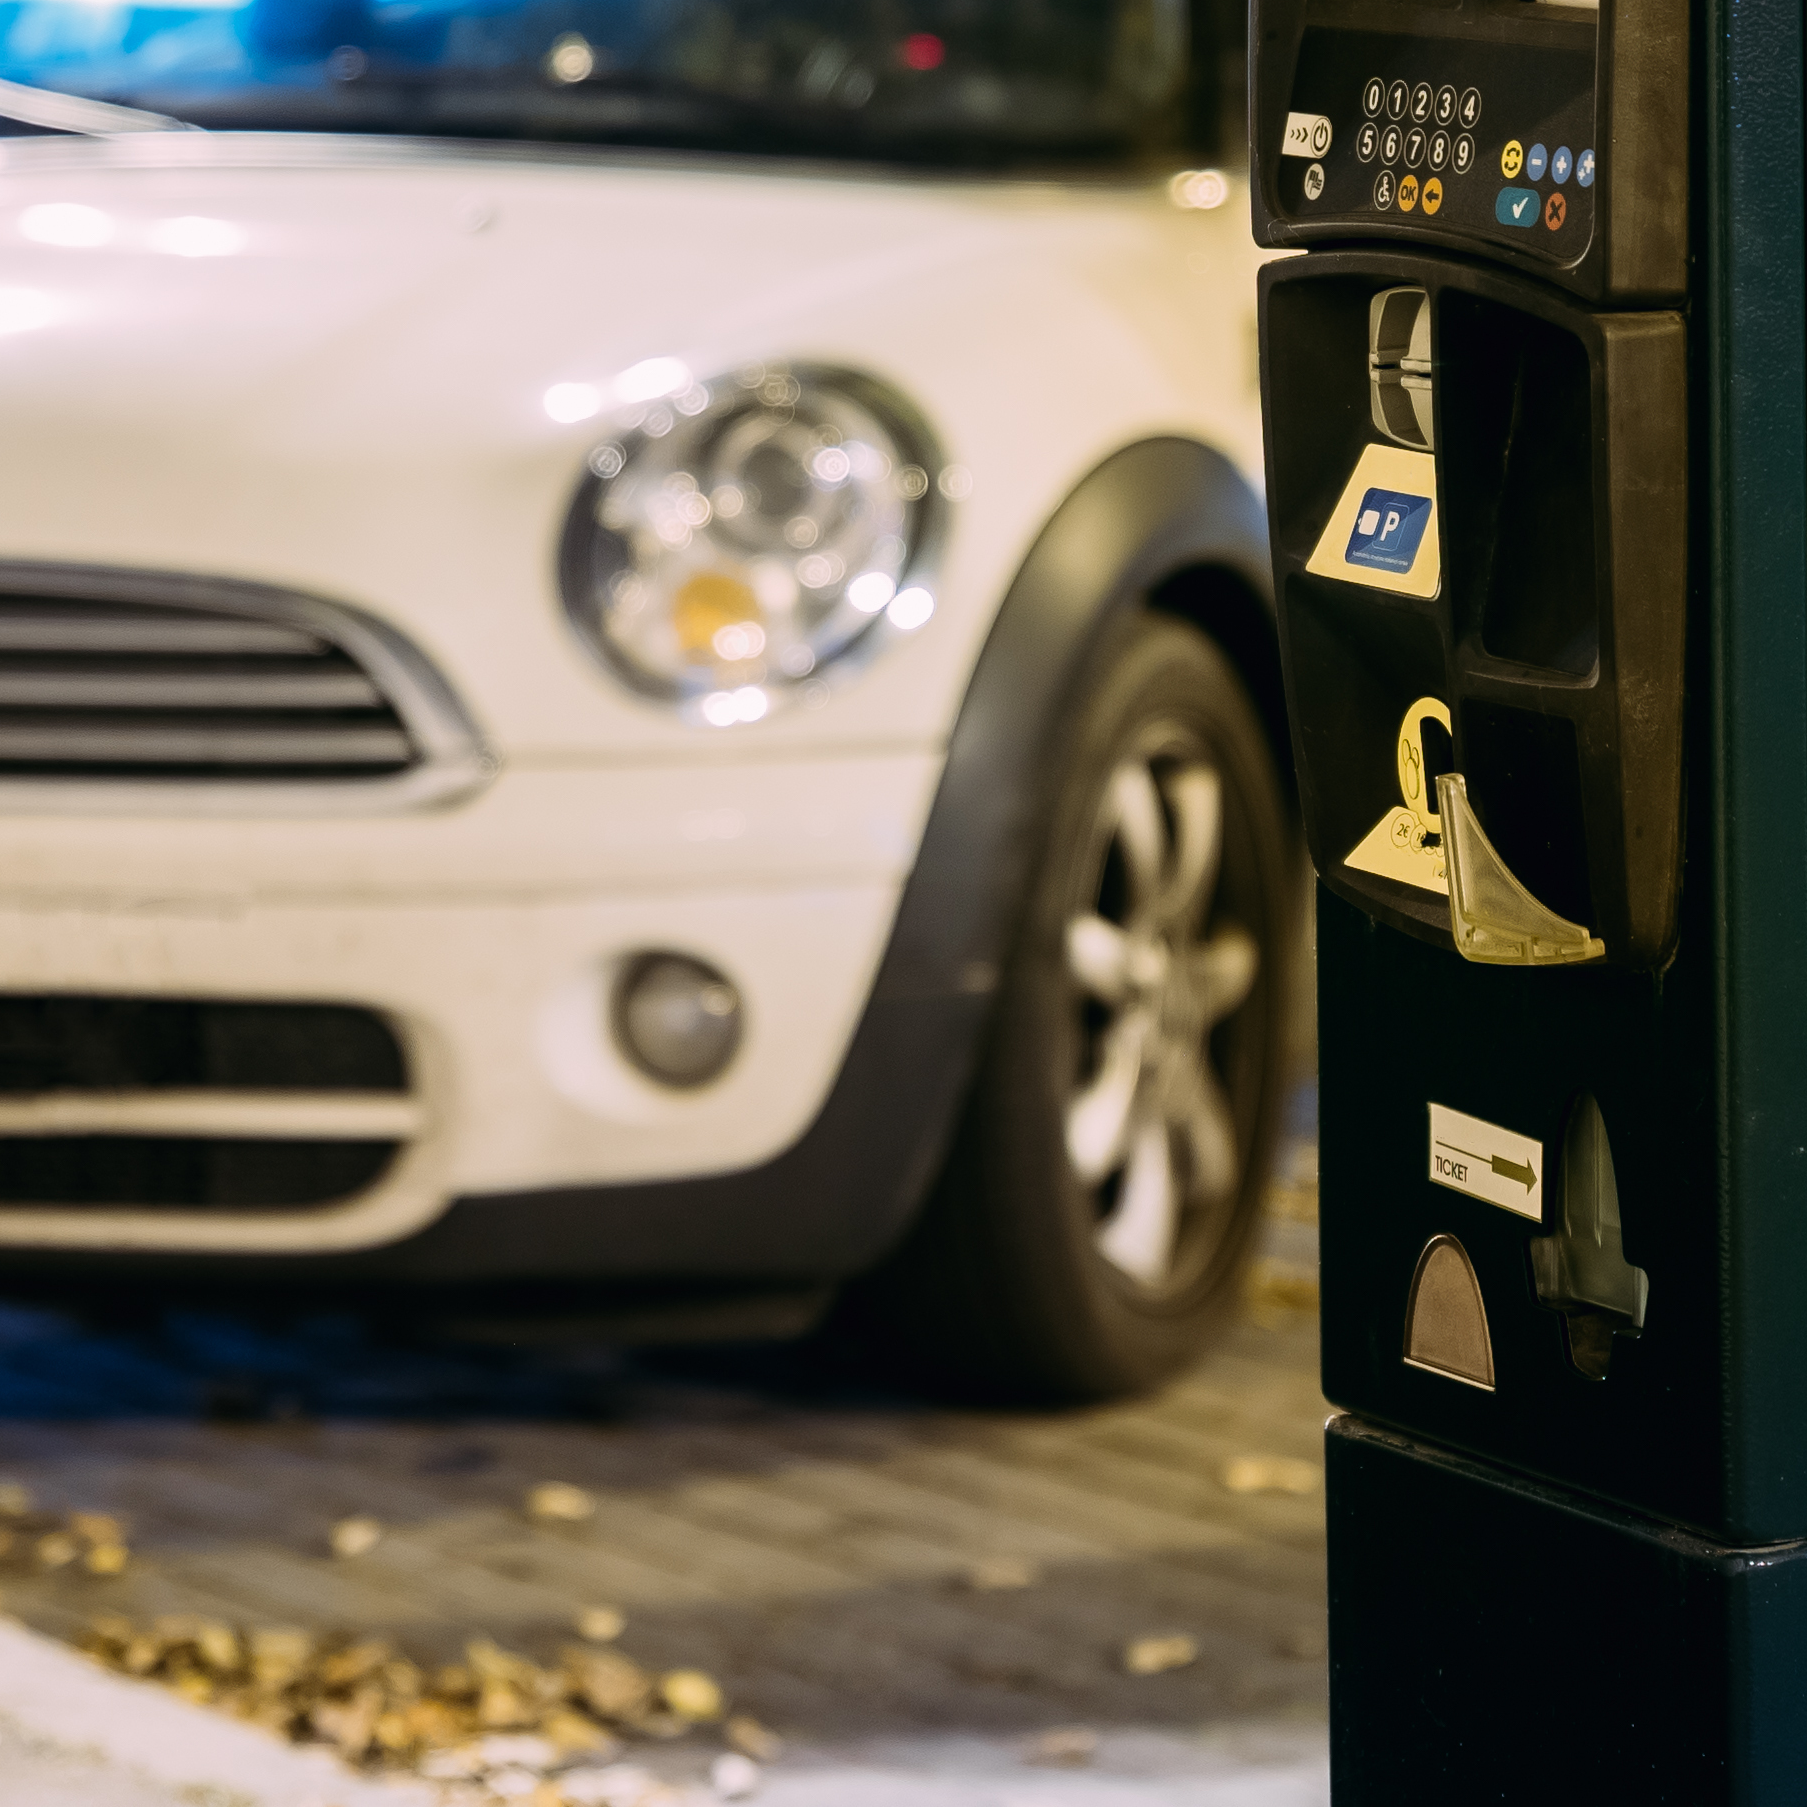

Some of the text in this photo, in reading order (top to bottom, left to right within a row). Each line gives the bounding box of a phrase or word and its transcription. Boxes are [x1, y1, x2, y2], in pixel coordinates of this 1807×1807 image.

[1369, 84, 1475, 121] 0 1 2 3 4
[1362, 129, 1469, 166] 5 6 7 8 9
[1400, 184, 1416, 201] OK
[1380, 510, 1400, 541] P
[1435, 1154, 1468, 1183] TICKET
